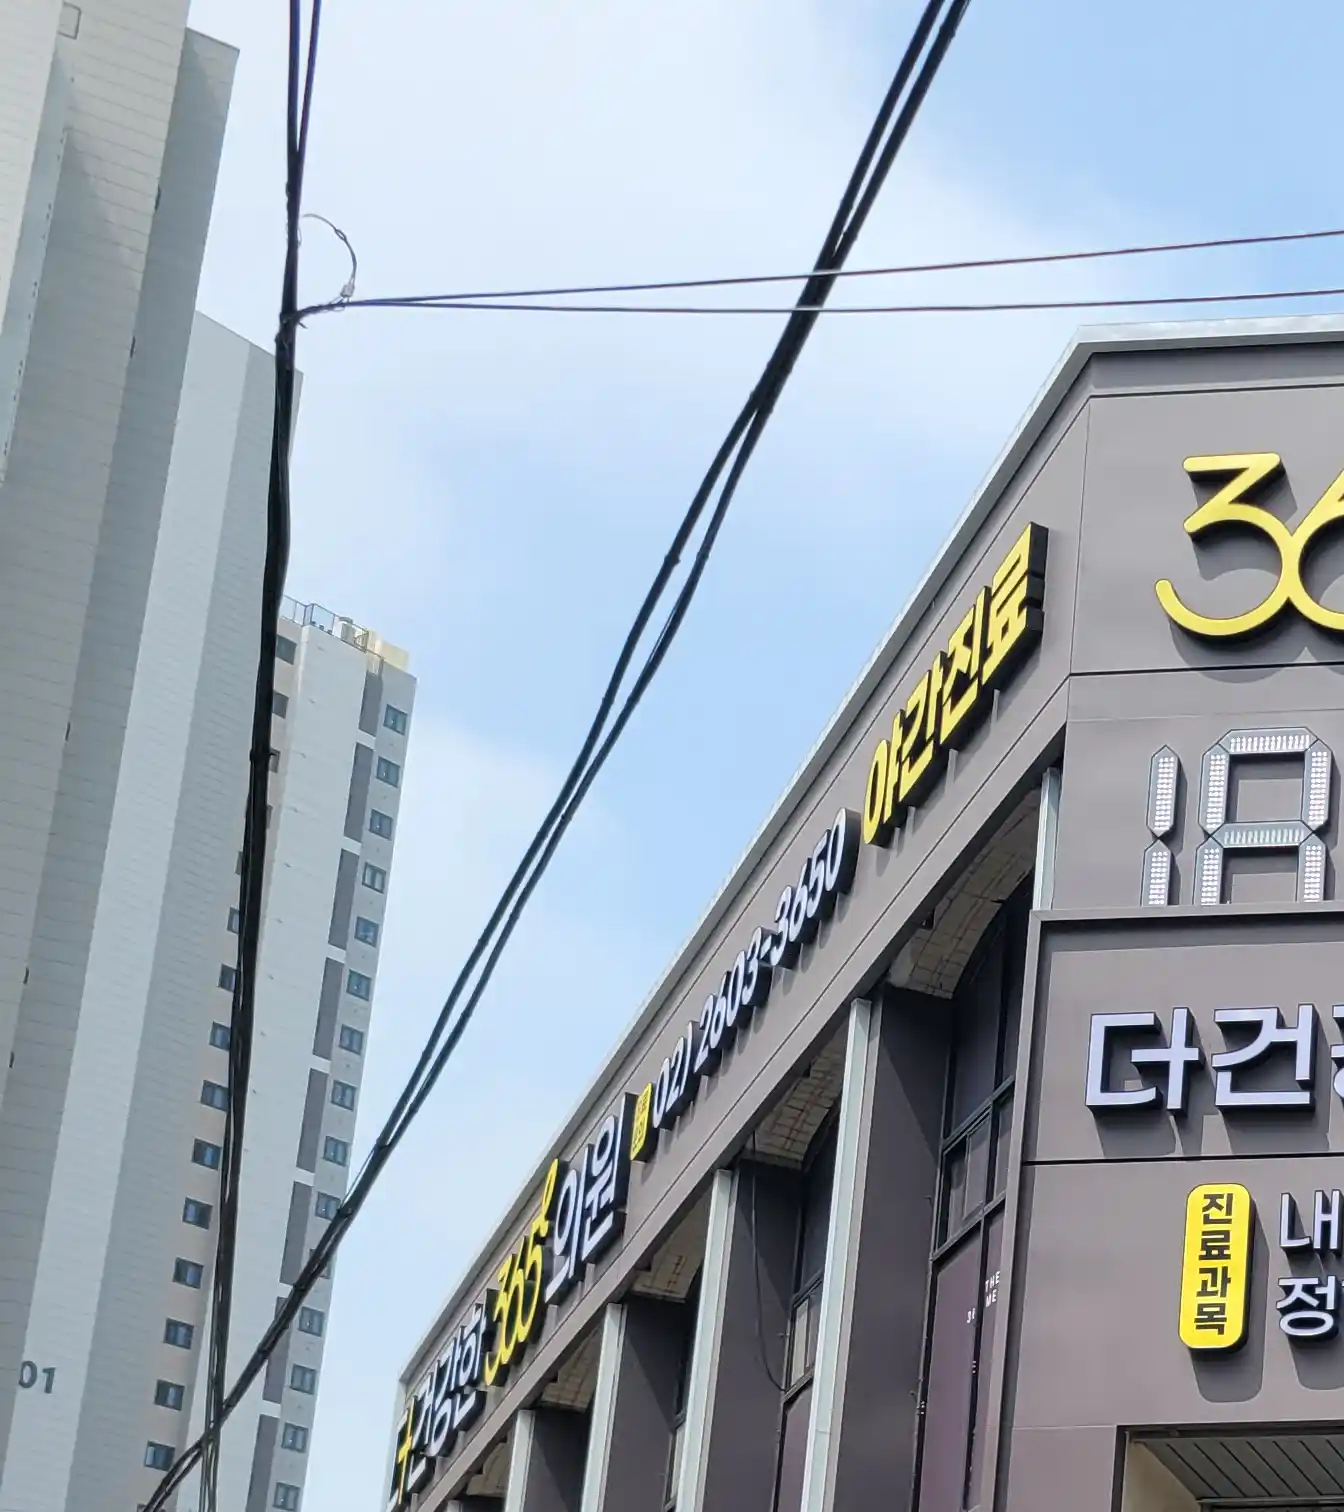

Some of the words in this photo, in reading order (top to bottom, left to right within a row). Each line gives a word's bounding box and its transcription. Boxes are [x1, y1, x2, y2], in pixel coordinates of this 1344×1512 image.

[483, 1158, 559, 1386] 365
[545, 1095, 625, 1303] 의원
[693, 807, 847, 1075] 2603-3650
[863, 522, 1033, 845] 야간진료
[1194, 1192, 1232, 1338] 진료과목
